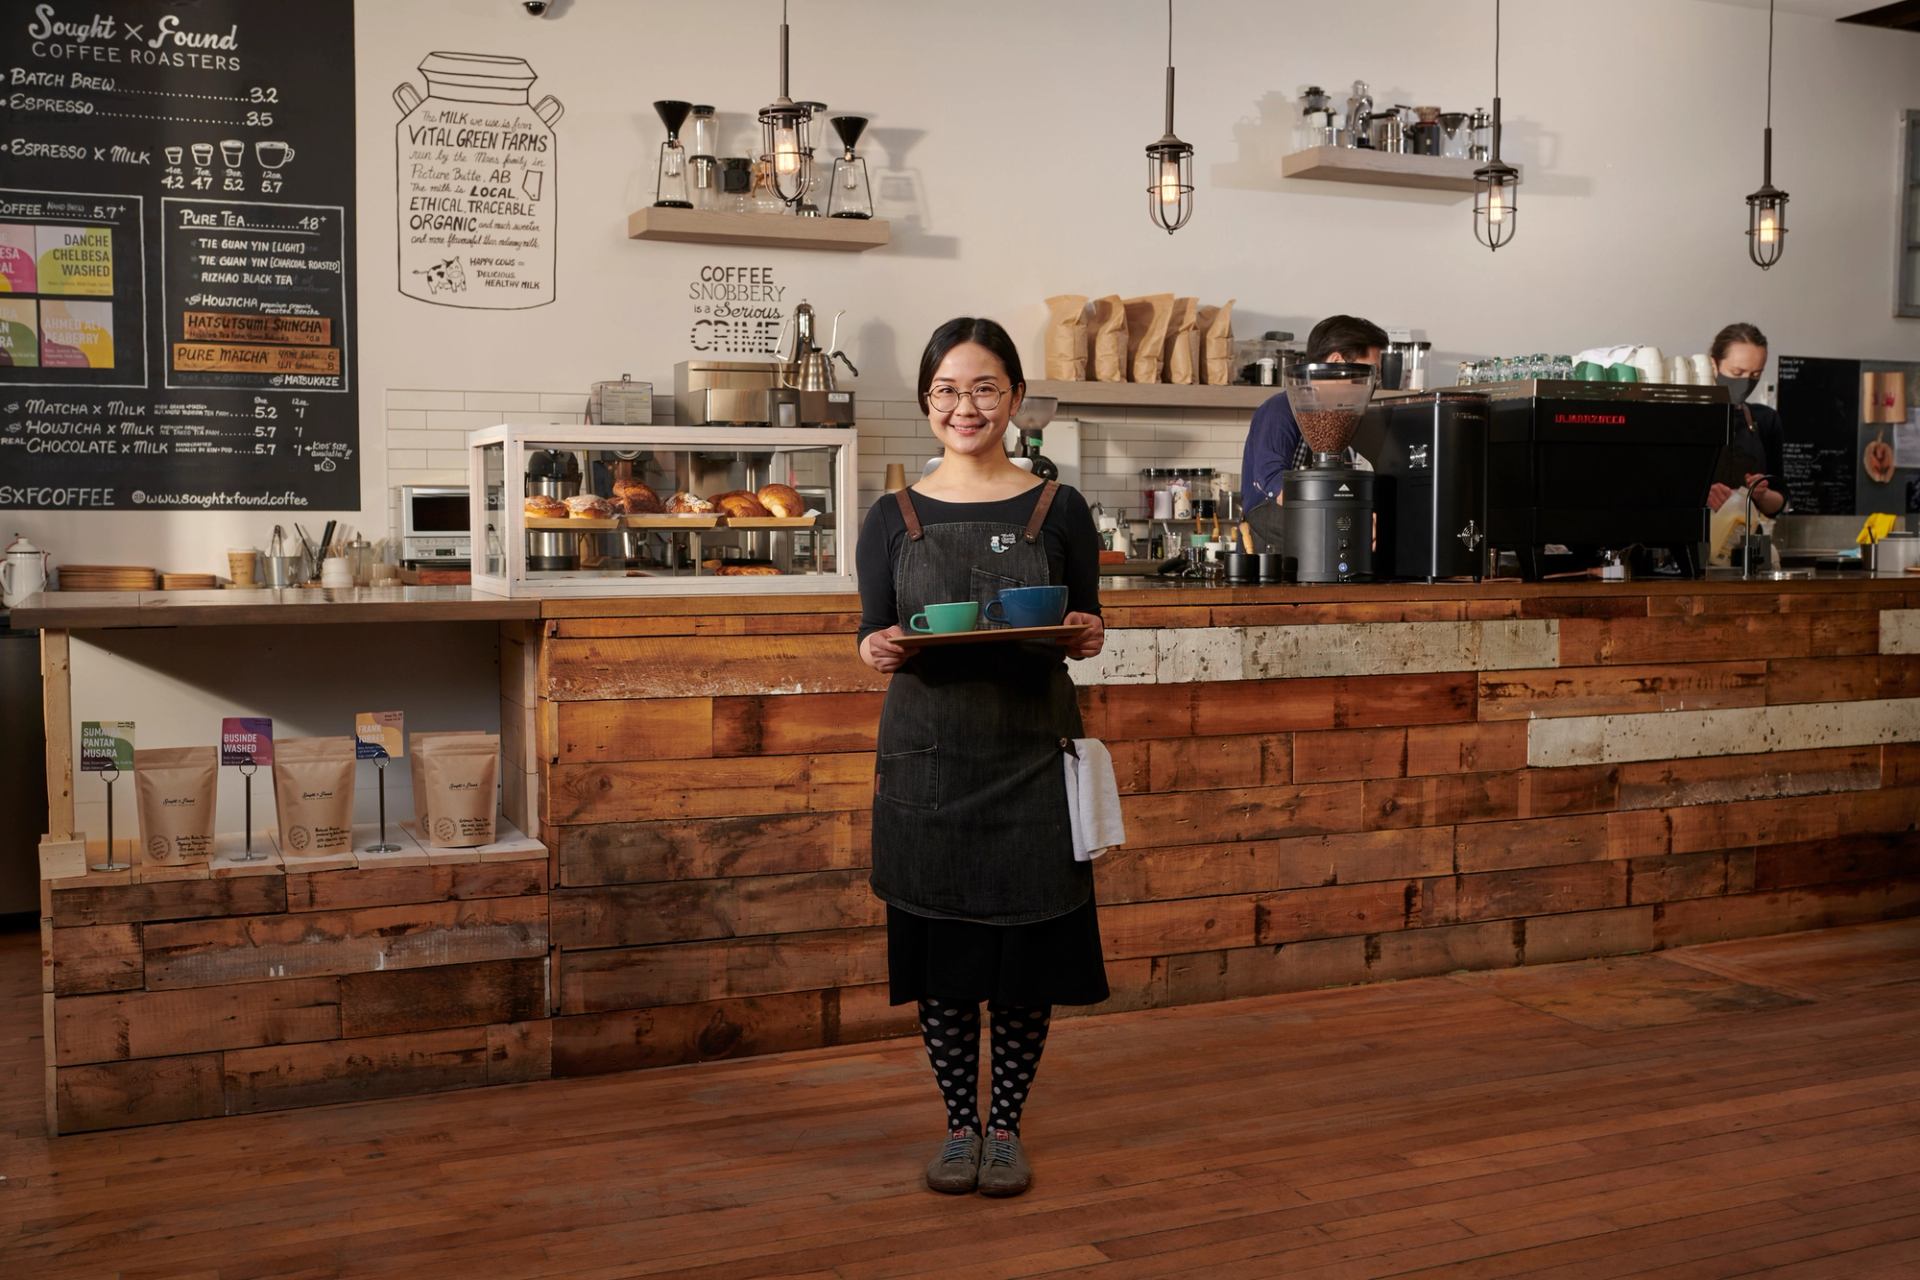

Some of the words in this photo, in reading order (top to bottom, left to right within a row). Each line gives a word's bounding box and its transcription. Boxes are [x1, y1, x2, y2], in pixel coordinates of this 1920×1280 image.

[28, 3, 117, 43] Sought
[148, 14, 238, 50] Found
[32, 41, 122, 62] COFFEE
[131, 49, 240, 71] ROASTERS
[10, 67, 65, 87] BATCH
[70, 72, 115, 92] BREW
[250, 87, 279, 104] 3.2
[10, 93, 94, 115] ESPRESSO
[246, 111, 273, 127] 3.5
[440, 111, 468, 125] MILK
[456, 128, 499, 149] GREEN
[501, 131, 548, 153] FARMS
[11, 138, 87, 160] ESPRESSO
[110, 145, 151, 165] MILK
[410, 163, 449, 180] Picture
[489, 169, 511, 184] AB
[161, 176, 185, 189] 4.2
[223, 178, 245, 191] 5.2
[261, 181, 283, 194] 5.7
[467, 200, 536, 217] TRACEABLE
[180, 209, 217, 225] PURE
[221, 211, 245, 227] TEA
[64, 234, 109, 247] DANCHE
[199, 238, 218, 249] TIE
[221, 239, 248, 250] GUAN
[251, 241, 269, 252] YIN
[52, 248, 110, 262] CHELBESA
[198, 255, 216, 266] TIE
[219, 256, 247, 267] GUAN
[251, 257, 268, 267] YIN
[470, 257, 494, 267] HAPPY
[495, 258, 515, 267] COWS
[61, 264, 110, 277] WASHED
[701, 266, 774, 284] COFFEE
[201, 272, 239, 283] RIZHAO
[242, 273, 272, 284] BLACK
[275, 275, 293, 285] TEA
[485, 280, 519, 289] HEALTHY
[521, 281, 540, 290] MILK
[689, 282, 786, 302] SNOBBERY
[202, 295, 258, 306] HOUJICHA
[694, 305, 702, 313] is
[714, 301, 784, 319] Serious
[272, 318, 322, 333] SHINCHA
[690, 319, 781, 353] CRIME
[178, 348, 214, 361] PURE
[220, 348, 268, 363] MATCHA
[284, 375, 340, 386] MATSUKAZE
[25, 399, 88, 414] MATCHA
[107, 400, 145, 415] MILK
[255, 407, 278, 419] 5.2
[26, 421, 101, 435] HOUJICHA
[121, 423, 154, 435] MILK
[255, 426, 276, 438] 5.7
[27, 438, 117, 453] CHOCOLATE
[134, 441, 168, 453] MILK
[255, 444, 276, 456] 5.7
[147, 491, 309, 508] www.soughtxfound.coffee
[83, 738, 115, 747] PANTAN
[224, 734, 257, 743] BUSINDE
[84, 749, 118, 758] MUSARA
[224, 744, 257, 753] WASHED
